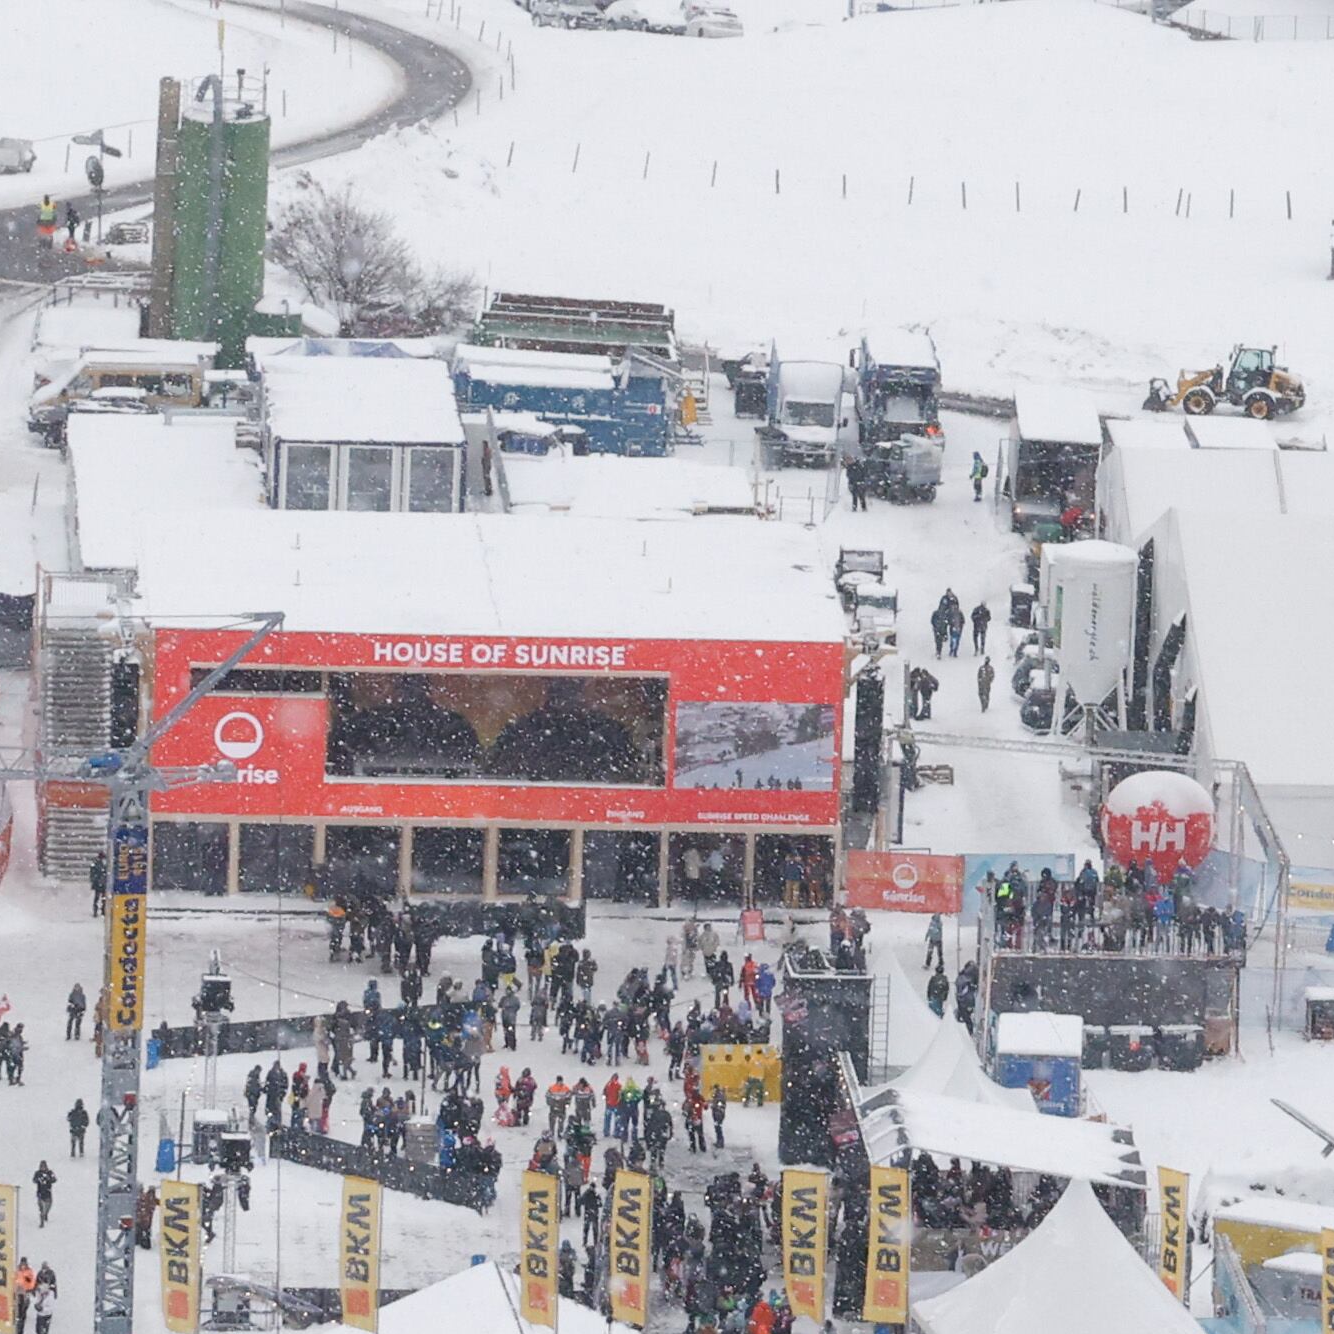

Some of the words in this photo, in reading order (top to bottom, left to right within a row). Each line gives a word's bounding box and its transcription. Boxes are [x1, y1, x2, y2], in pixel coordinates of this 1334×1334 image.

[373, 642, 463, 664] HOUSE
[471, 644, 507, 665] OF
[515, 645, 626, 666] SUNRISE
[1131, 821, 1186, 850] HH
[117, 897, 140, 1026] Condecta
